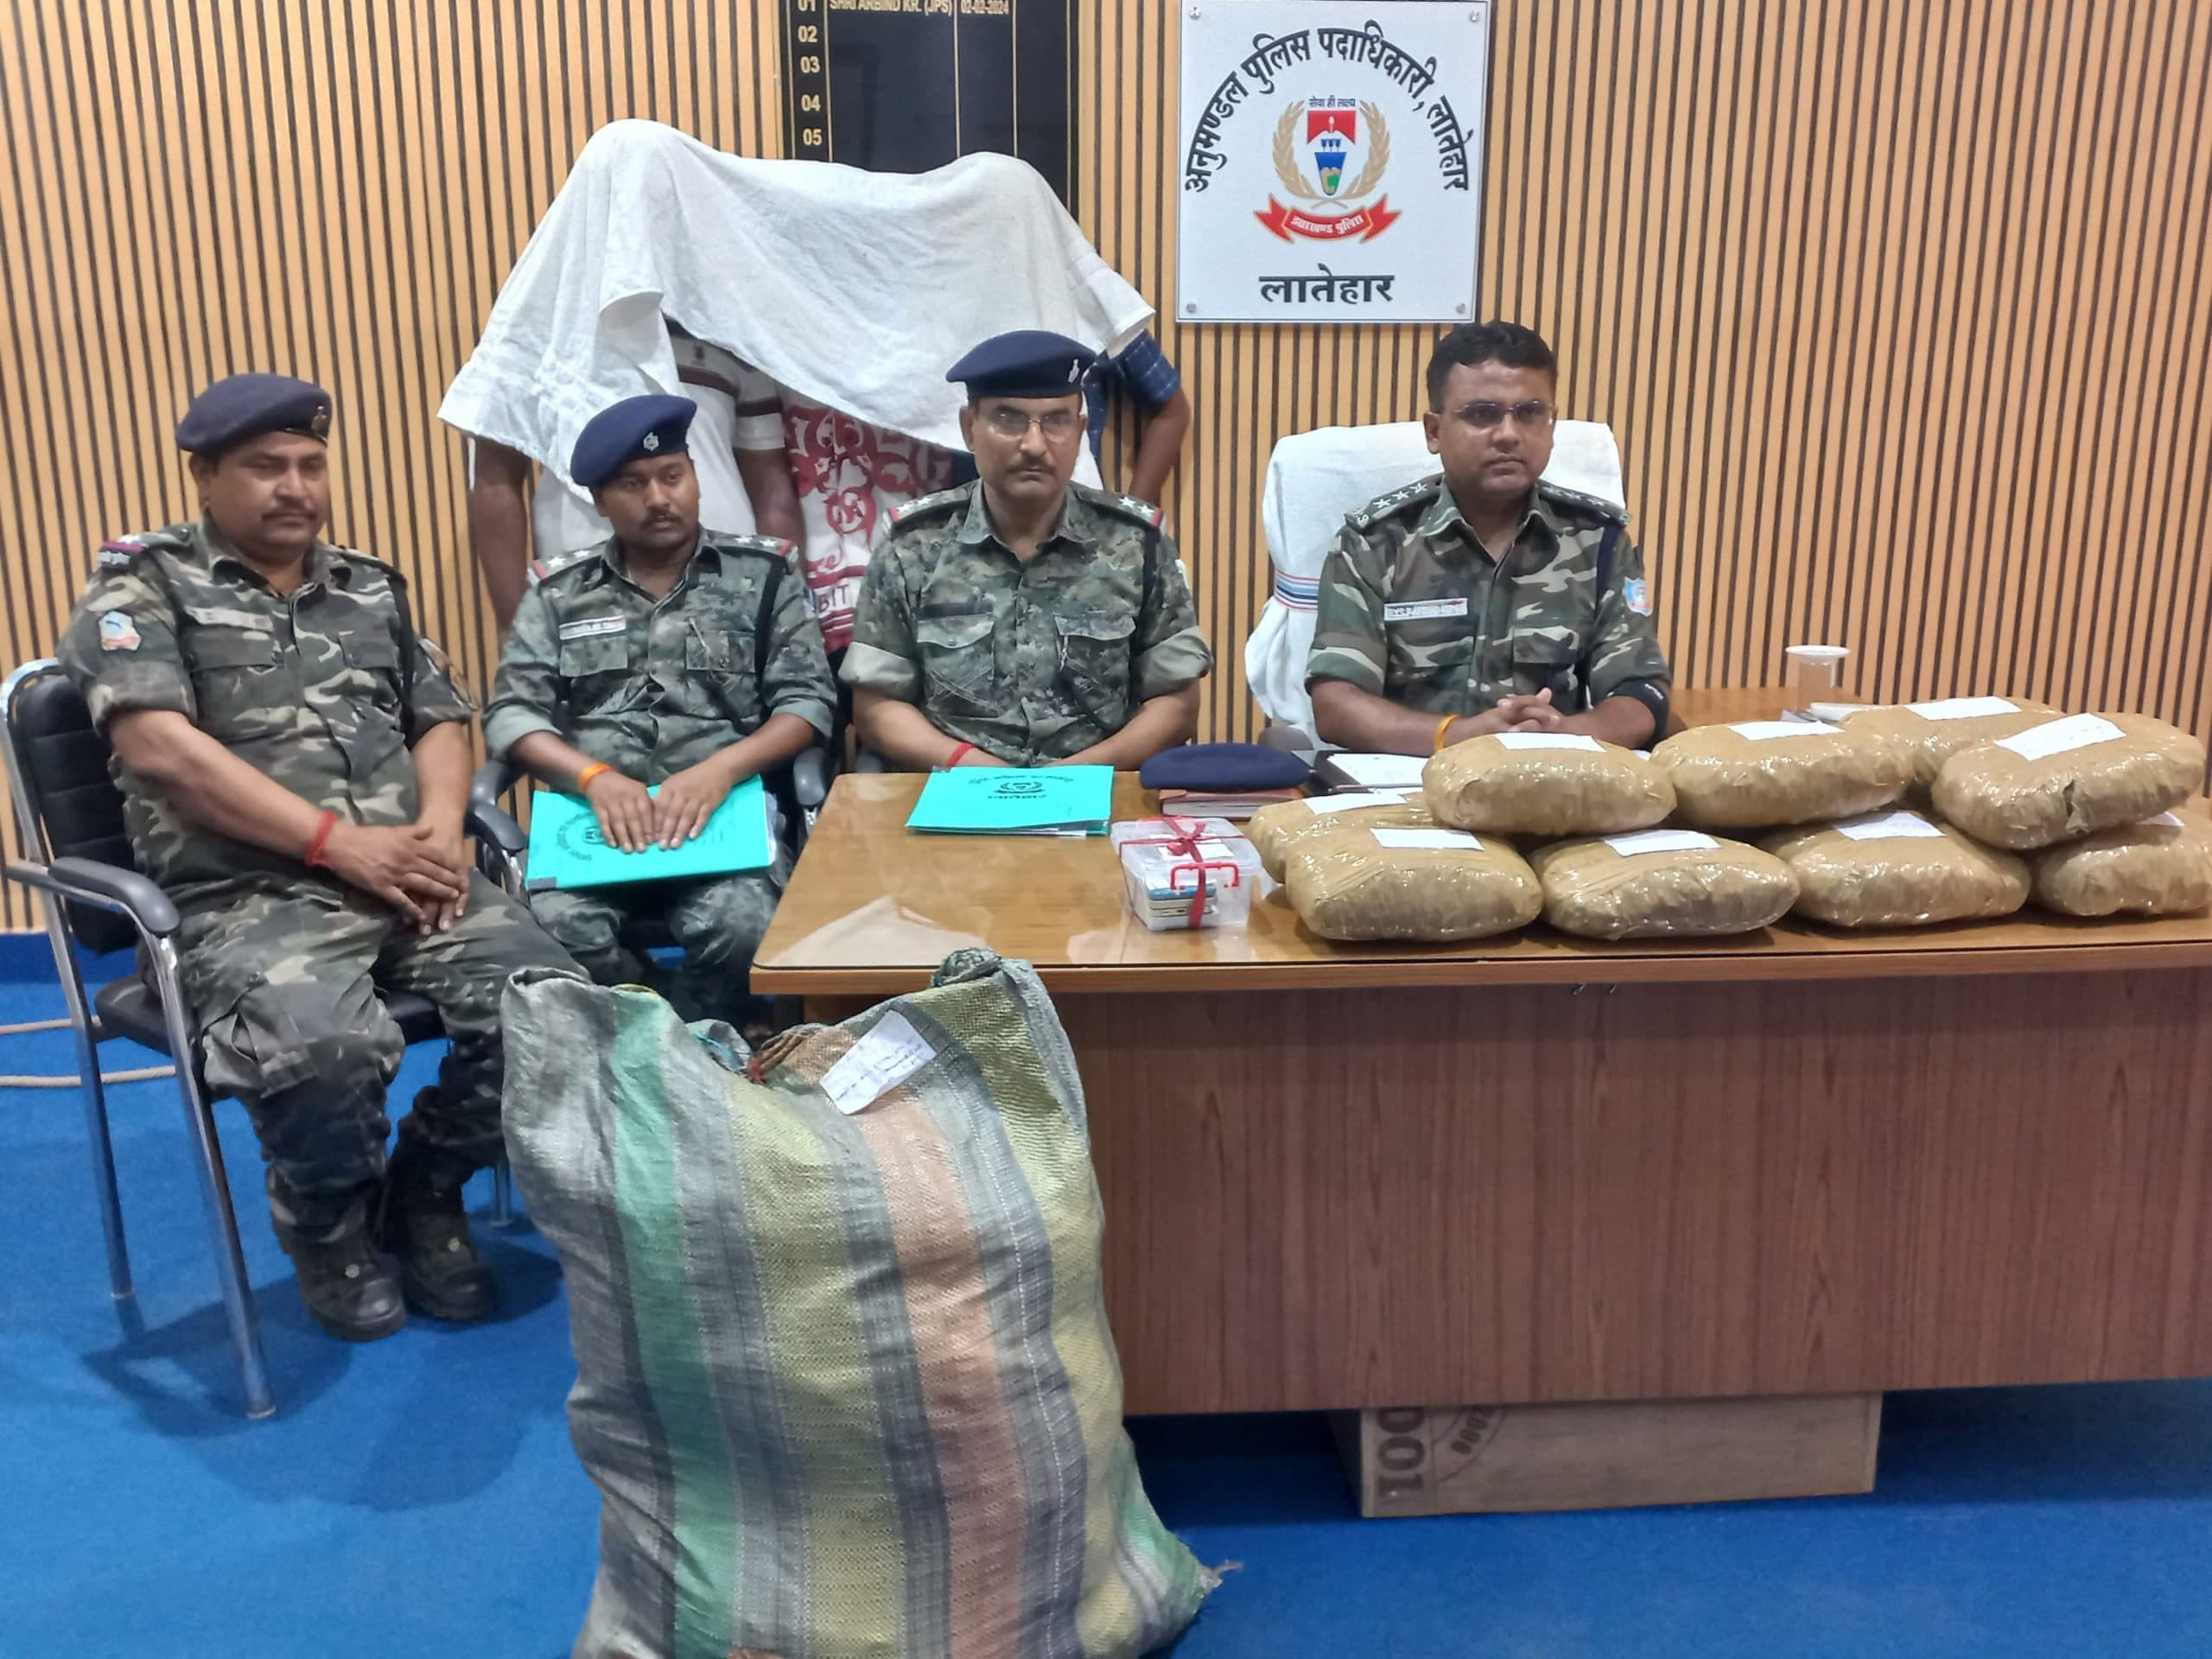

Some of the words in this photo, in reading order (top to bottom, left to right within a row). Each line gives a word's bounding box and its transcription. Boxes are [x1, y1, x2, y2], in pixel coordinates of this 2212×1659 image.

[798, 0, 817, 11] 01
[798, 25, 817, 43] 02
[800, 56, 820, 73] 03
[801, 94, 821, 111] 04
[1185, 71, 1249, 193] अनुमण्डल
[1240, 29, 1312, 94] पुलिस
[1427, 95, 1474, 191] लातेहार
[803, 129, 823, 146] 05
[1258, 263, 1395, 304] लातेहार
